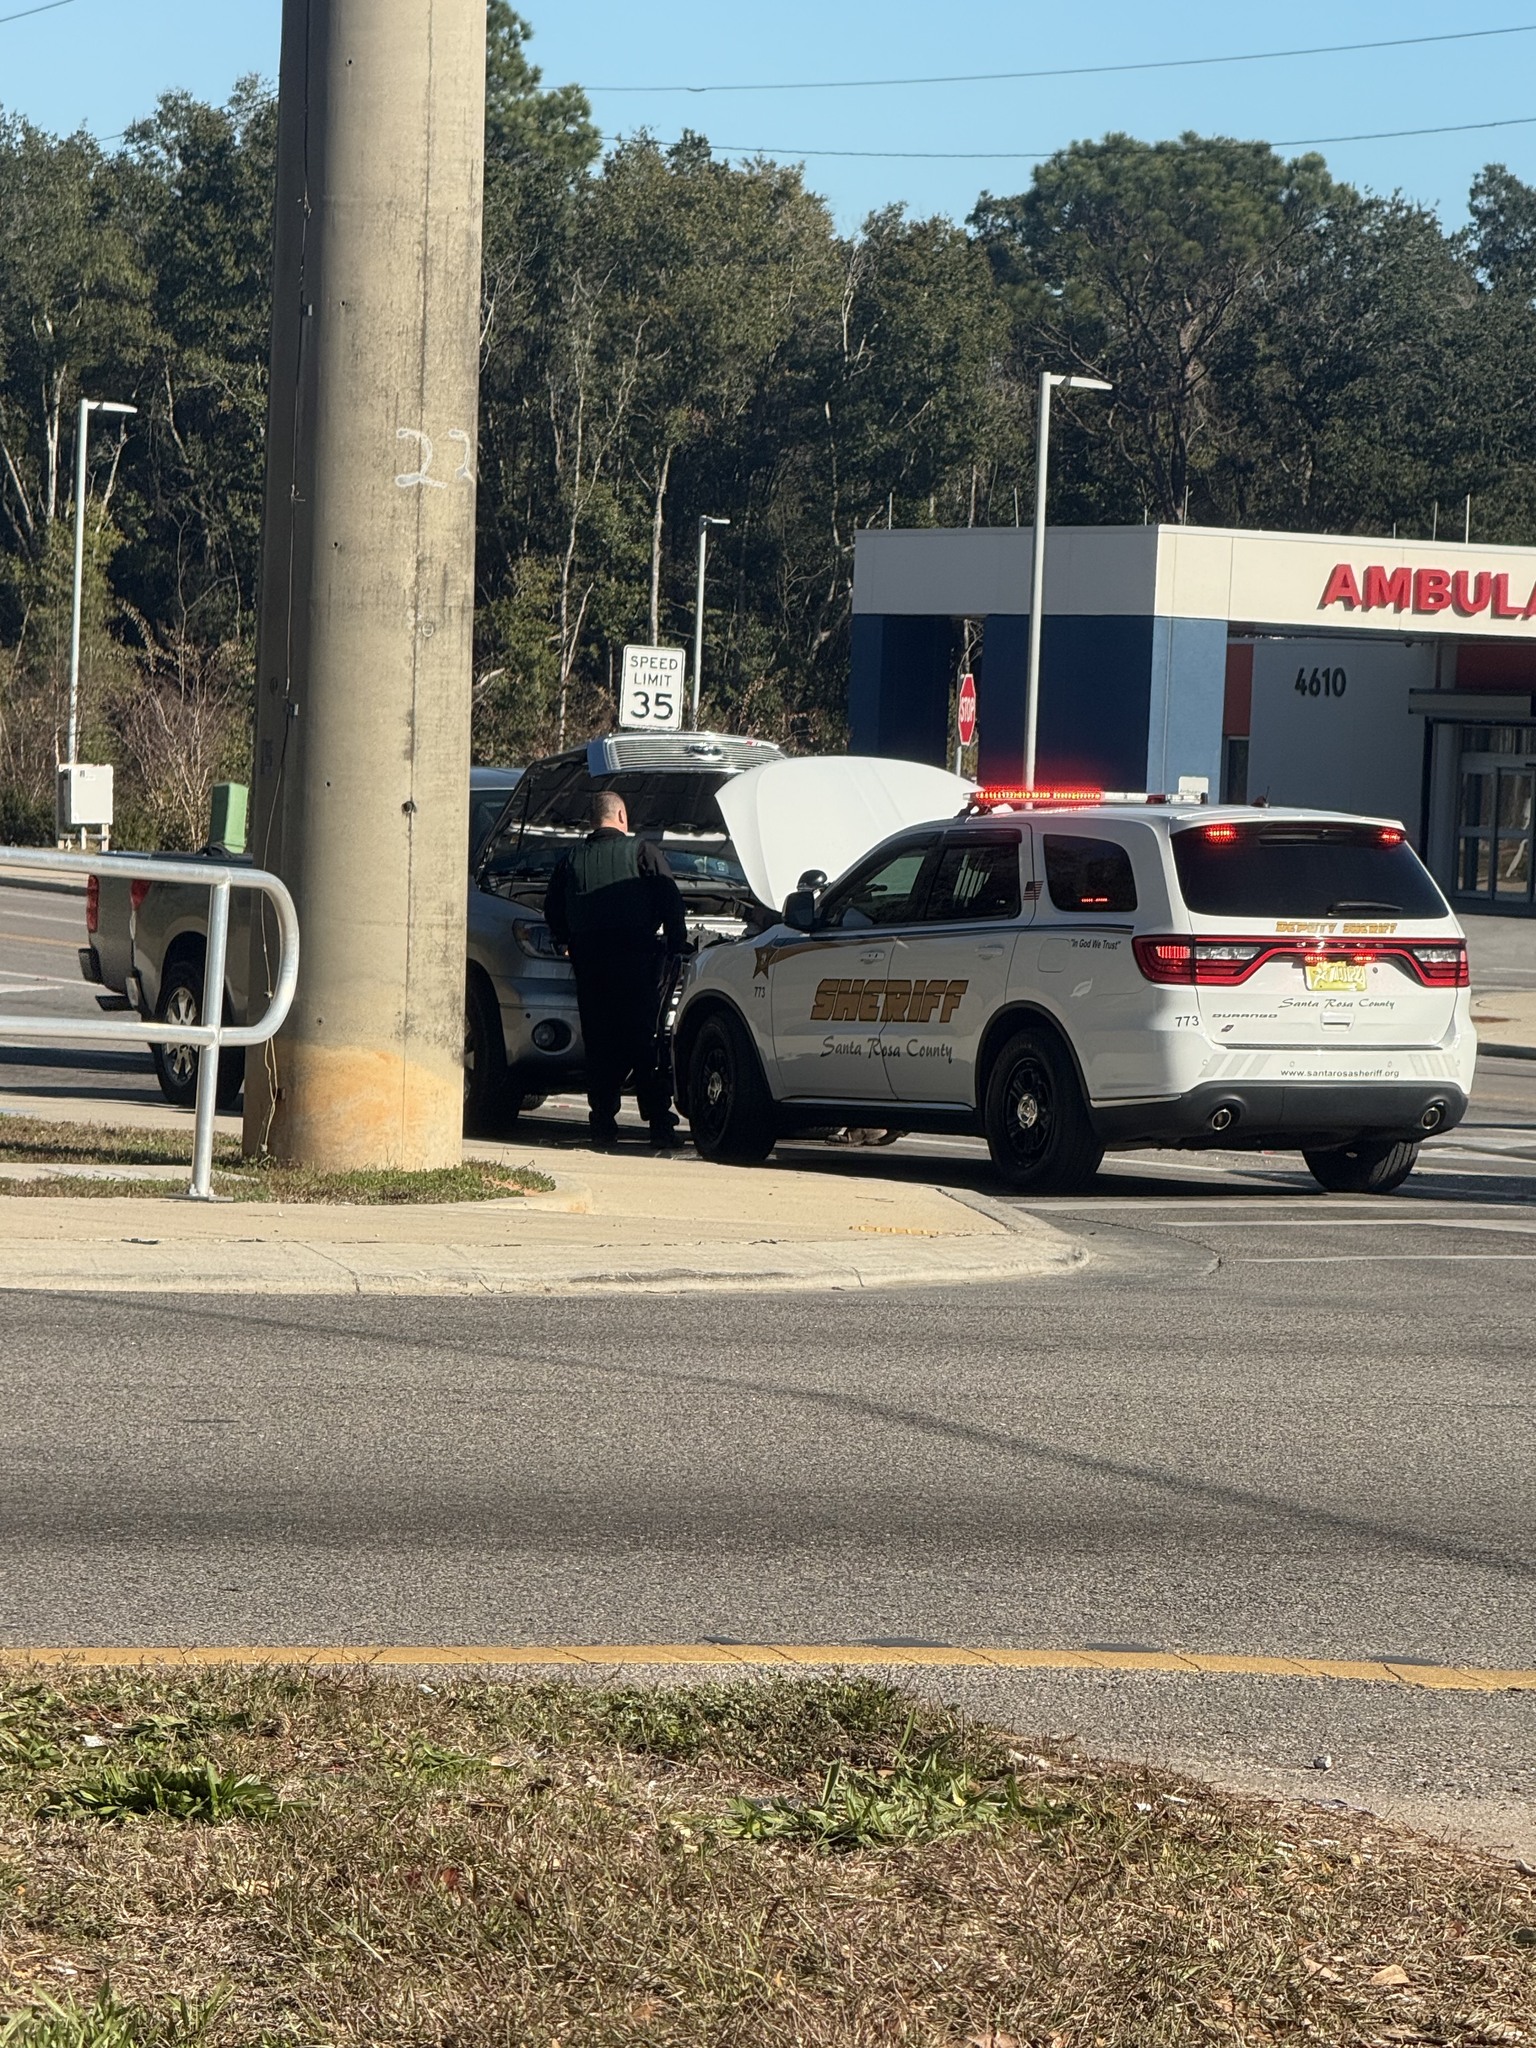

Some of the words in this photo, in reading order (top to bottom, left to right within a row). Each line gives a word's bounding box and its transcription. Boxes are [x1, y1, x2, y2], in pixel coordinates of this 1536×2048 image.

[630, 655, 678, 670] SPEED
[633, 672, 672, 687] LIMIT
[1295, 667, 1346, 697] 4610
[630, 691, 673, 720] 35
[960, 696, 975, 723] STOP
[1276, 921, 1337, 933] DEPUTY
[1342, 923, 1398, 934] SHERIFF
[1079, 939, 1092, 948] God
[1092, 940, 1101, 949] We
[754, 986, 766, 998] 773
[810, 979, 969, 1023] SHERIFF
[1278, 998, 1319, 1008] Santa
[1324, 998, 1353, 1008] Rosa
[1358, 998, 1395, 1009] County
[1175, 1015, 1199, 1027] 773
[820, 1035, 862, 1057] Santa
[867, 1038, 900, 1059] Rosa
[906, 1039, 952, 1064] County
[1280, 1069, 1400, 1078] www.santarosasheriff.org
